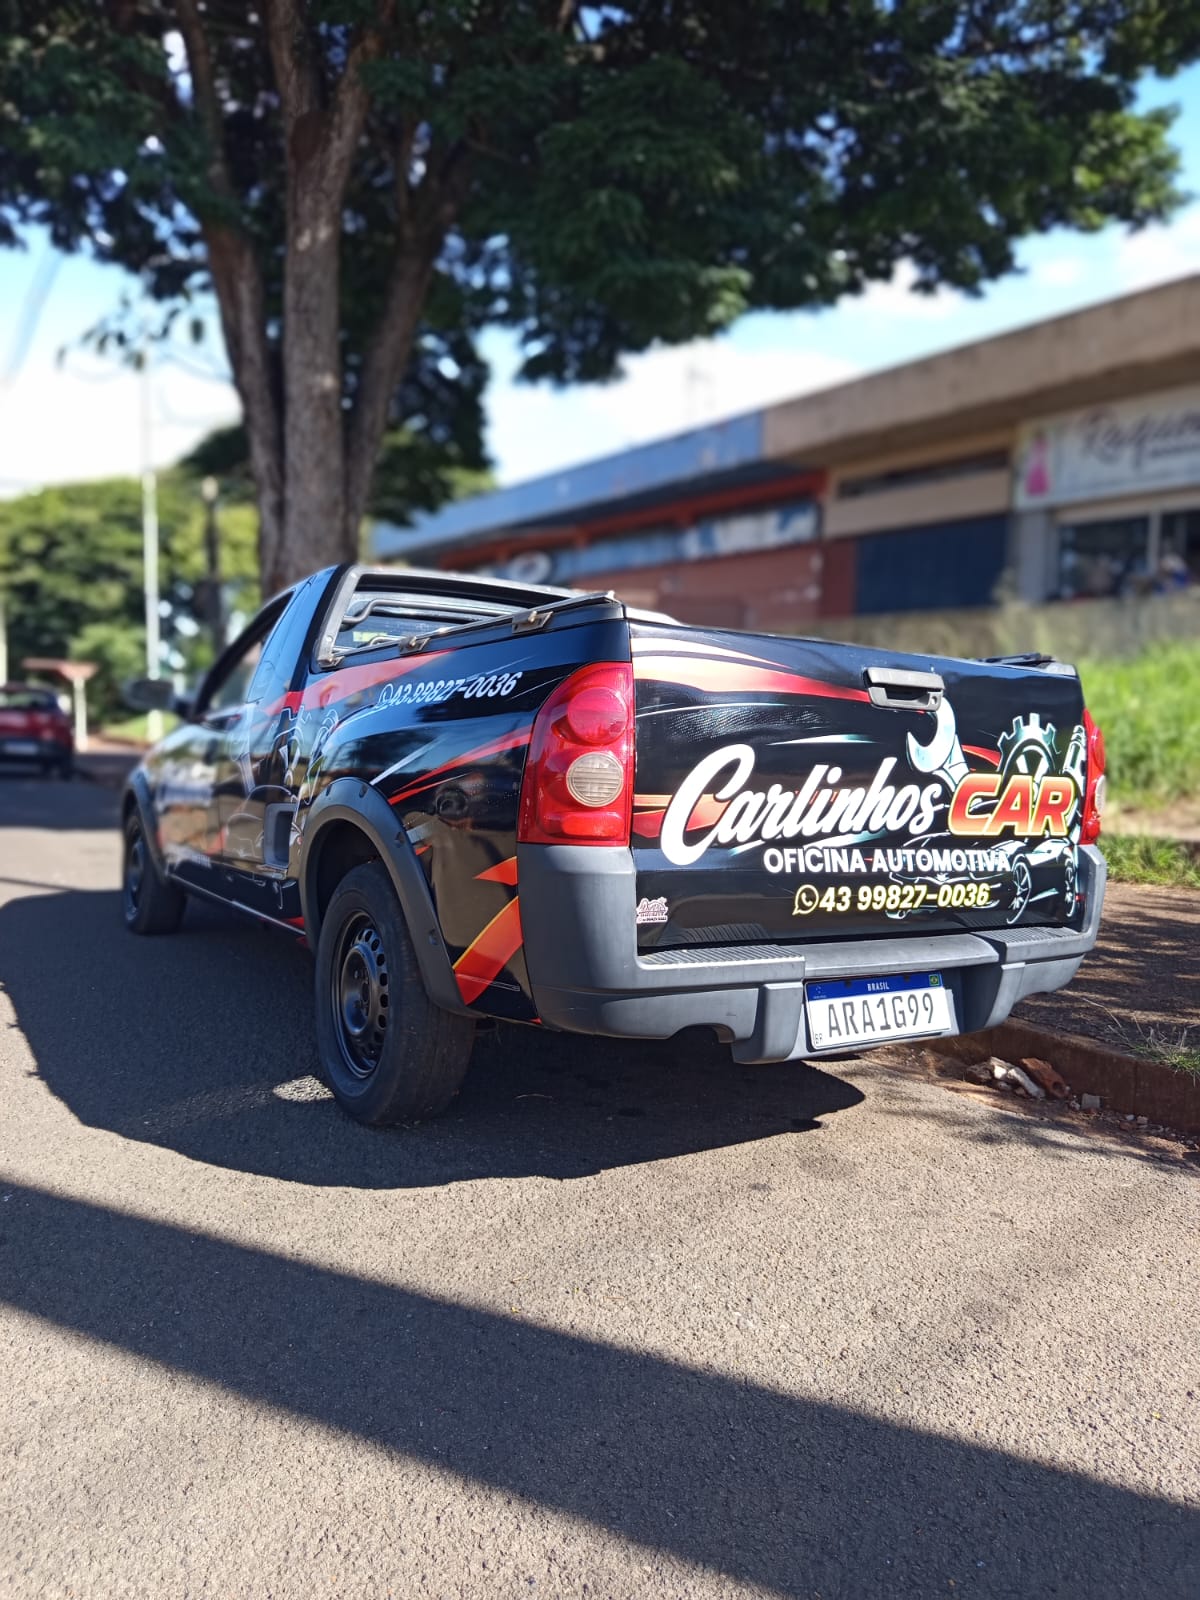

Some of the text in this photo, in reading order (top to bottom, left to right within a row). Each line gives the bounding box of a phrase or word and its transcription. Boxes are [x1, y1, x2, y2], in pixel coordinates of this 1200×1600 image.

[660, 743, 1076, 866] Carlinhos CAR
[763, 847, 1012, 874] OFICINA AUTOMOTIVA
[819, 883, 991, 912] 43 99827-0036
[867, 981, 890, 992] BRASIL
[828, 992, 934, 1038] ARA1G99
